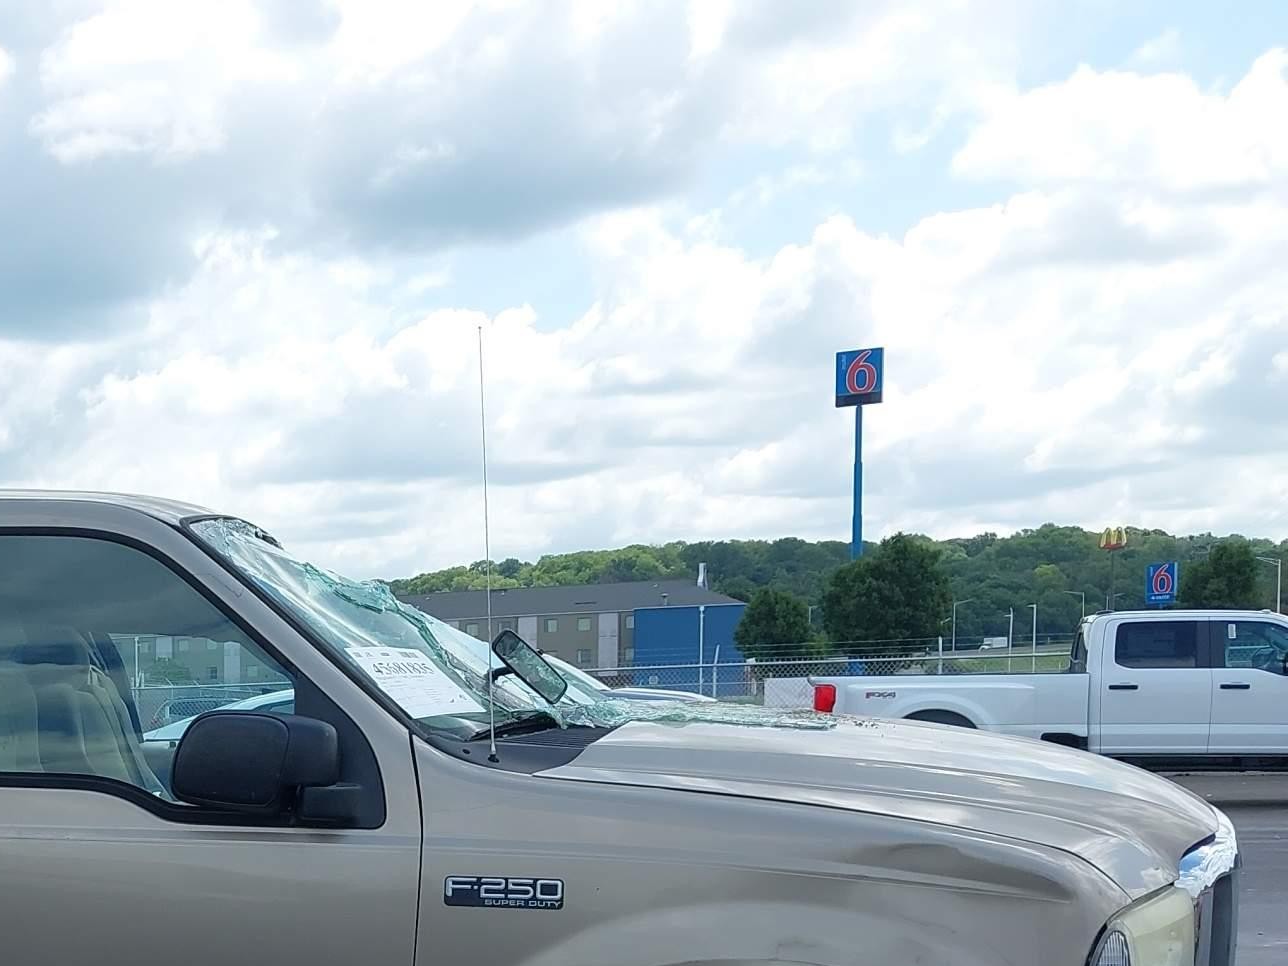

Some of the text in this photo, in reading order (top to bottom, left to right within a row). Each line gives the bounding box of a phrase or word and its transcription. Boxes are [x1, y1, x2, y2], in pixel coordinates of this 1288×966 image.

[846, 350, 877, 394] 6
[1153, 563, 1172, 594] 6
[484, 899, 562, 908] SUPER DUTY
